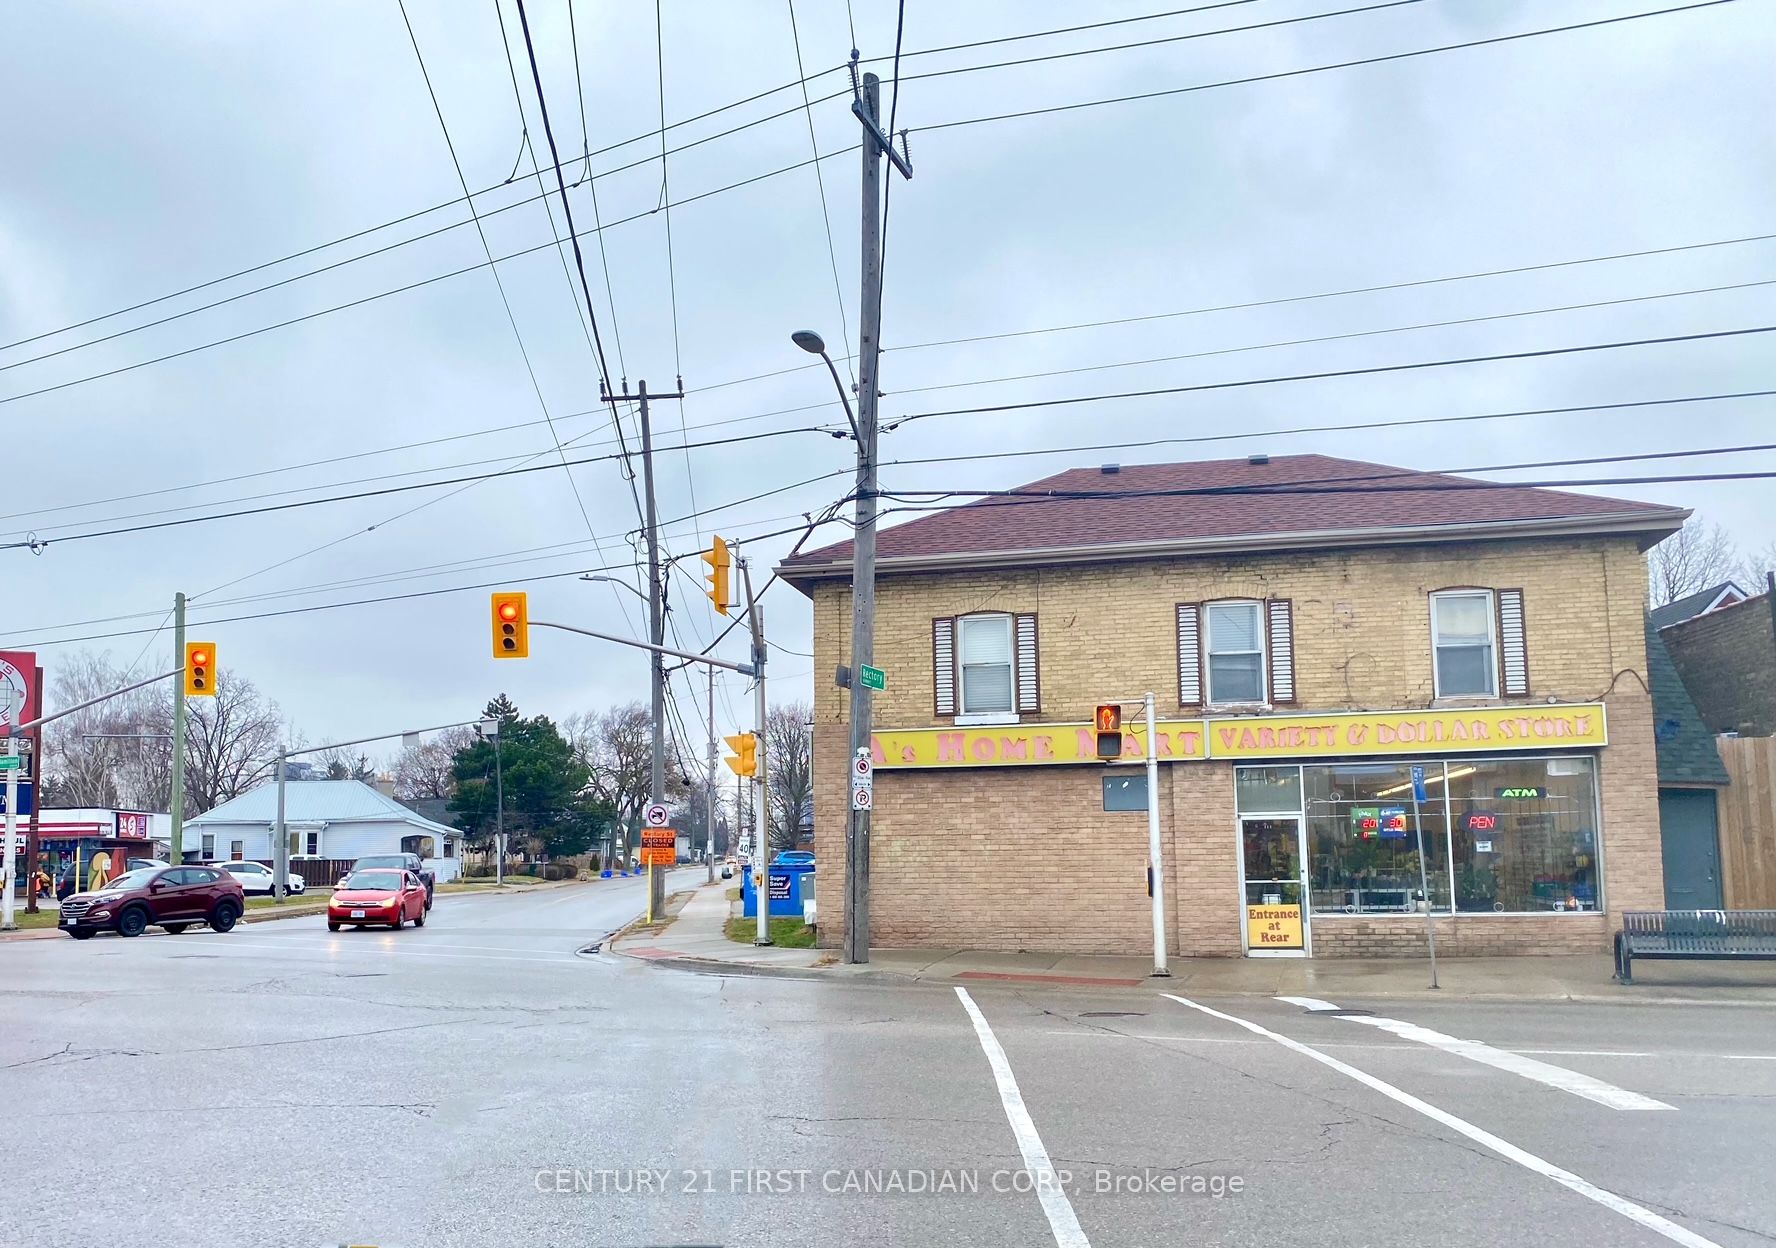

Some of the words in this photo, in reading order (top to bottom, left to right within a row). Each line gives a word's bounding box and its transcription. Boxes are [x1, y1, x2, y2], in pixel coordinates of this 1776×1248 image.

[863, 668, 882, 684] Rectory
[1219, 726, 1337, 749] VARIETY
[1377, 719, 1490, 744] DOLLAR
[1499, 714, 1594, 738] STORE
[936, 733, 1055, 762] HOME
[1502, 789, 1537, 797] ATM
[1389, 819, 1404, 828] 30
[739, 844, 749, 853] 40
[1249, 909, 1299, 920] Entrance
[1268, 921, 1281, 931] at
[1260, 932, 1290, 943] Rear
